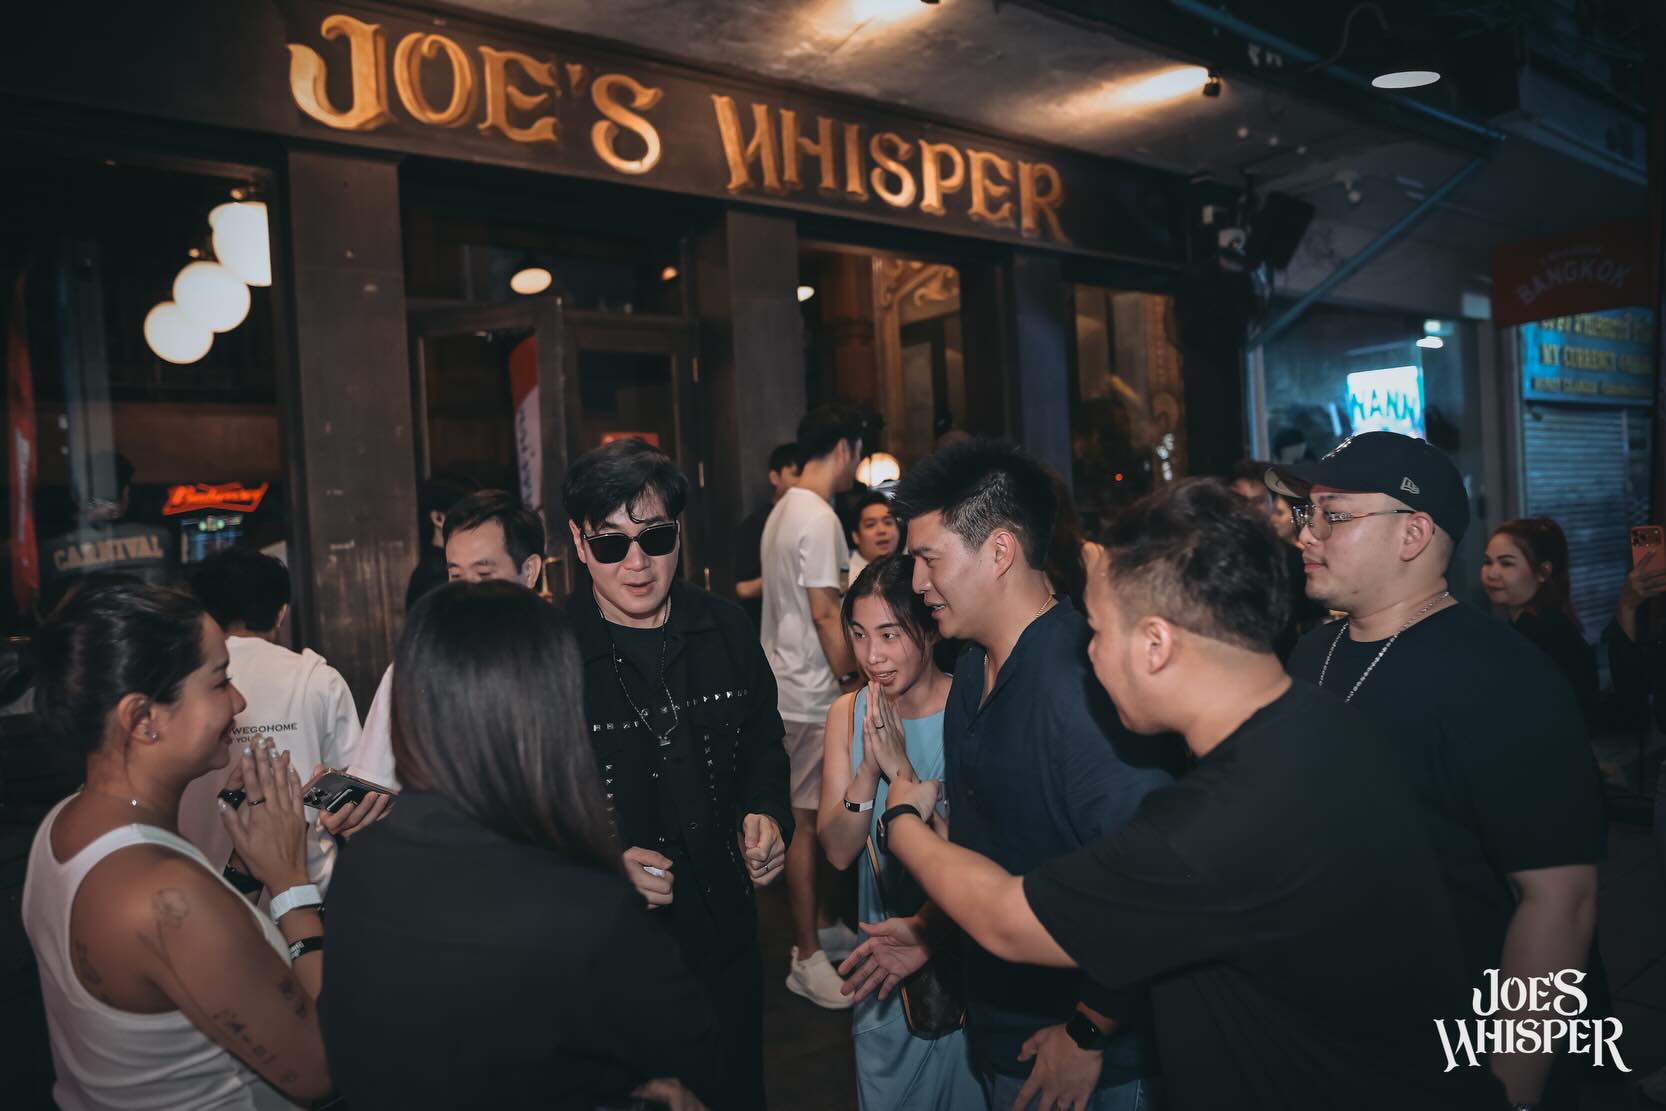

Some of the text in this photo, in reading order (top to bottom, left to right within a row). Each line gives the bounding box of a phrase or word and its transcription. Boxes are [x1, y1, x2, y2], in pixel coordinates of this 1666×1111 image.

[288, 14, 1067, 242] JOE'S WHISPER
[1513, 256, 1633, 304] BANGKOK
